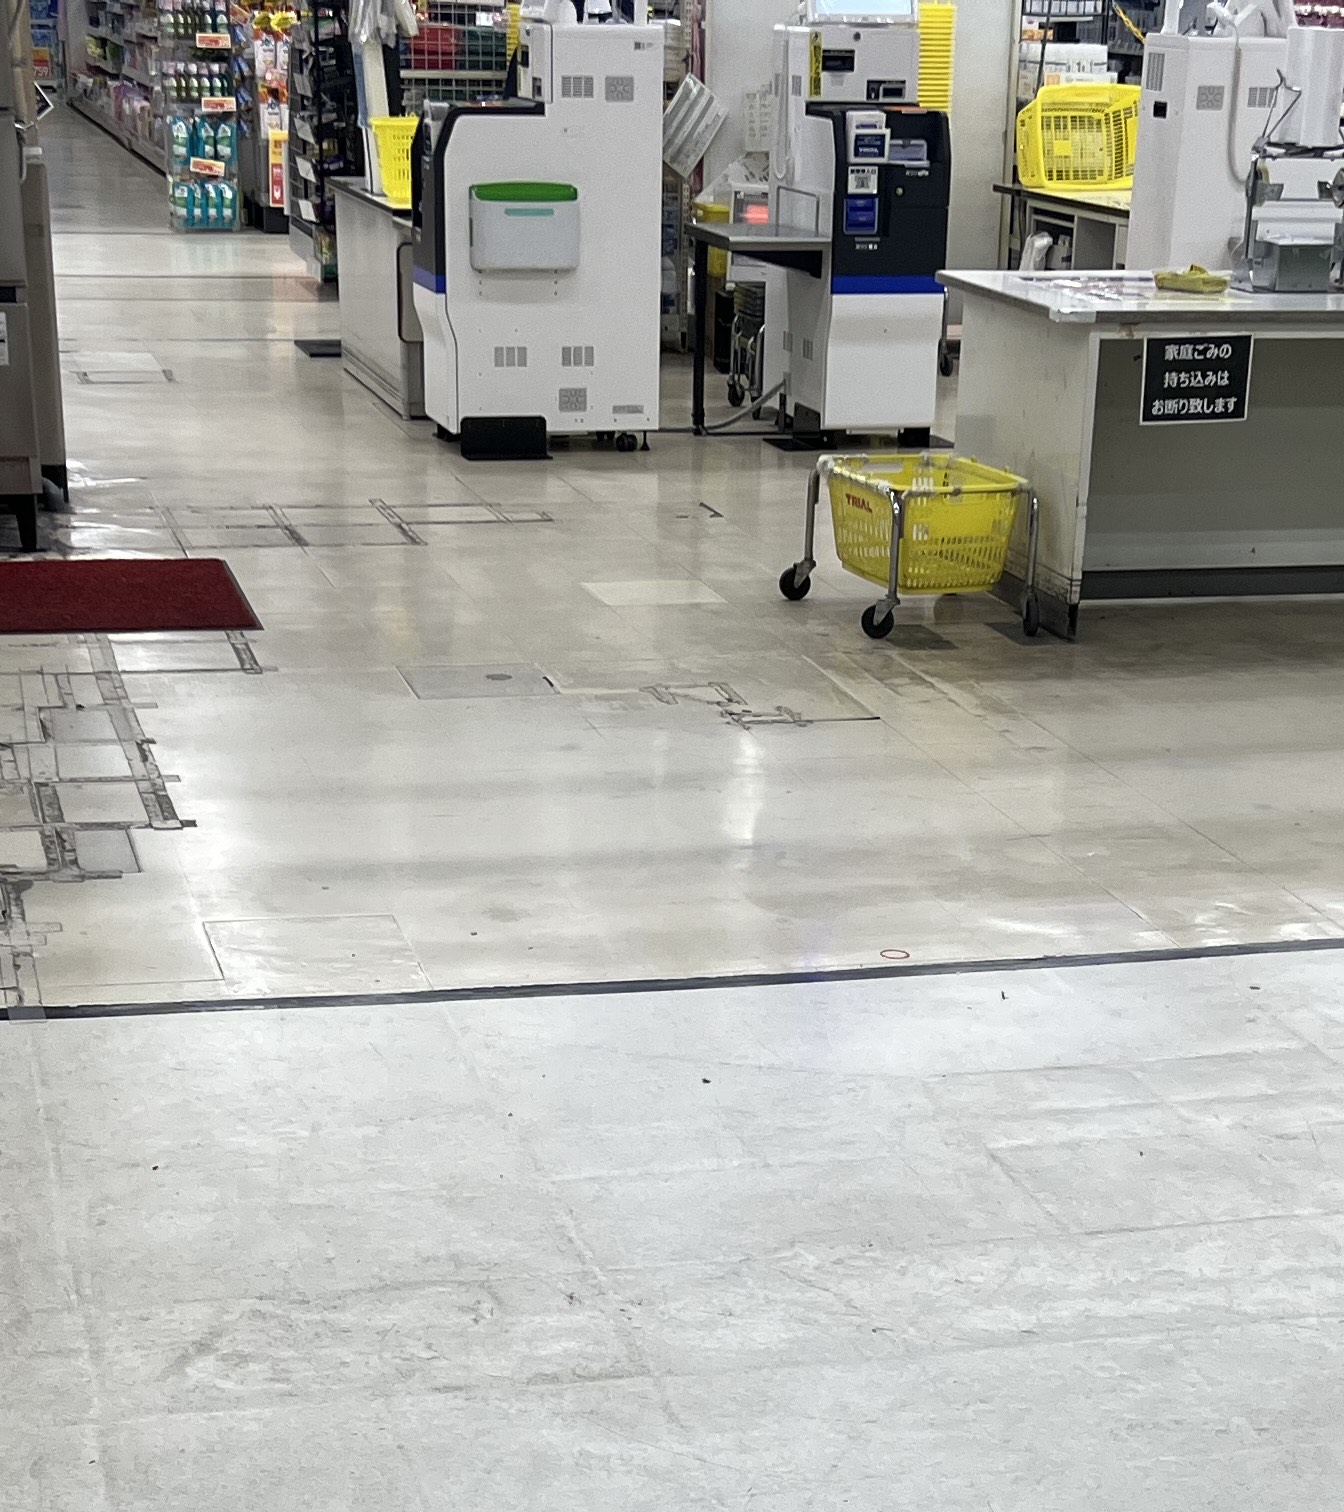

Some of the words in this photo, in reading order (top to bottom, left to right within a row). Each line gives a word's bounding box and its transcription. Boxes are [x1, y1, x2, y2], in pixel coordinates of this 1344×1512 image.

[1164, 343, 1233, 361] 家庭ごみの
[1162, 370, 1230, 389] 持ち込みは
[1151, 397, 1238, 416] お断り致します
[845, 493, 873, 513] TRIAL
